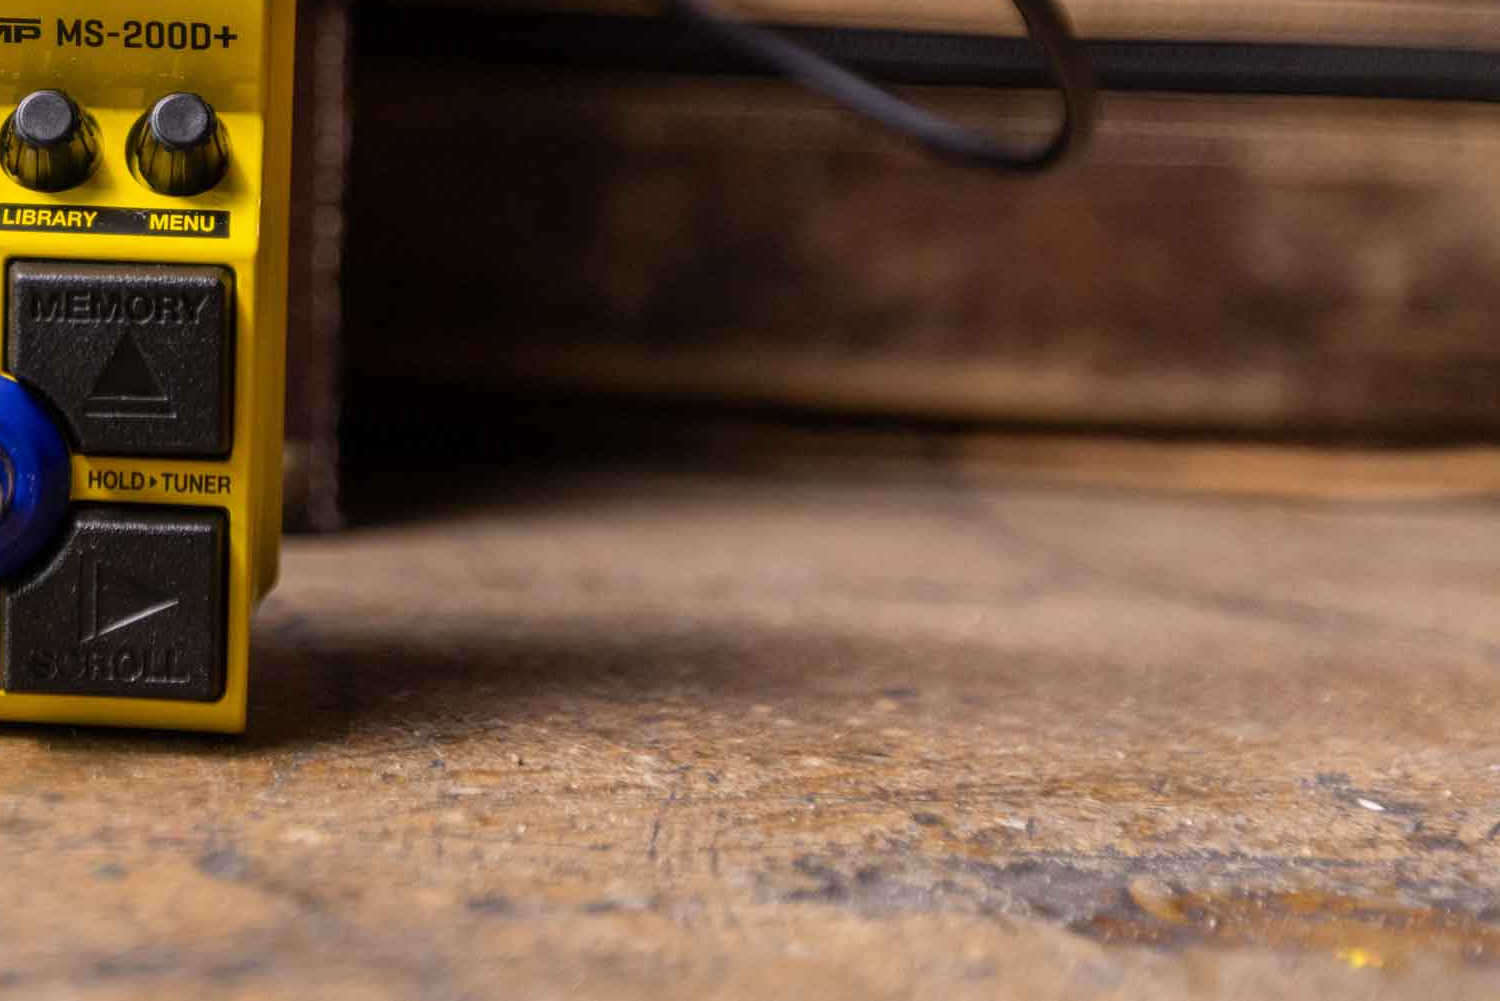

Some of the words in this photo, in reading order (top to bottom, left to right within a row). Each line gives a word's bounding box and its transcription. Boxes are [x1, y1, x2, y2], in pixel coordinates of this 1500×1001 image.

[56, 20, 239, 49] MS-200D+
[1, 208, 98, 228] LIBRARY
[148, 213, 216, 232] MENU
[28, 286, 211, 325] MEMORY
[88, 470, 145, 491] HOLD
[161, 474, 232, 495] TUNER
[26, 644, 192, 685] SCROLL
